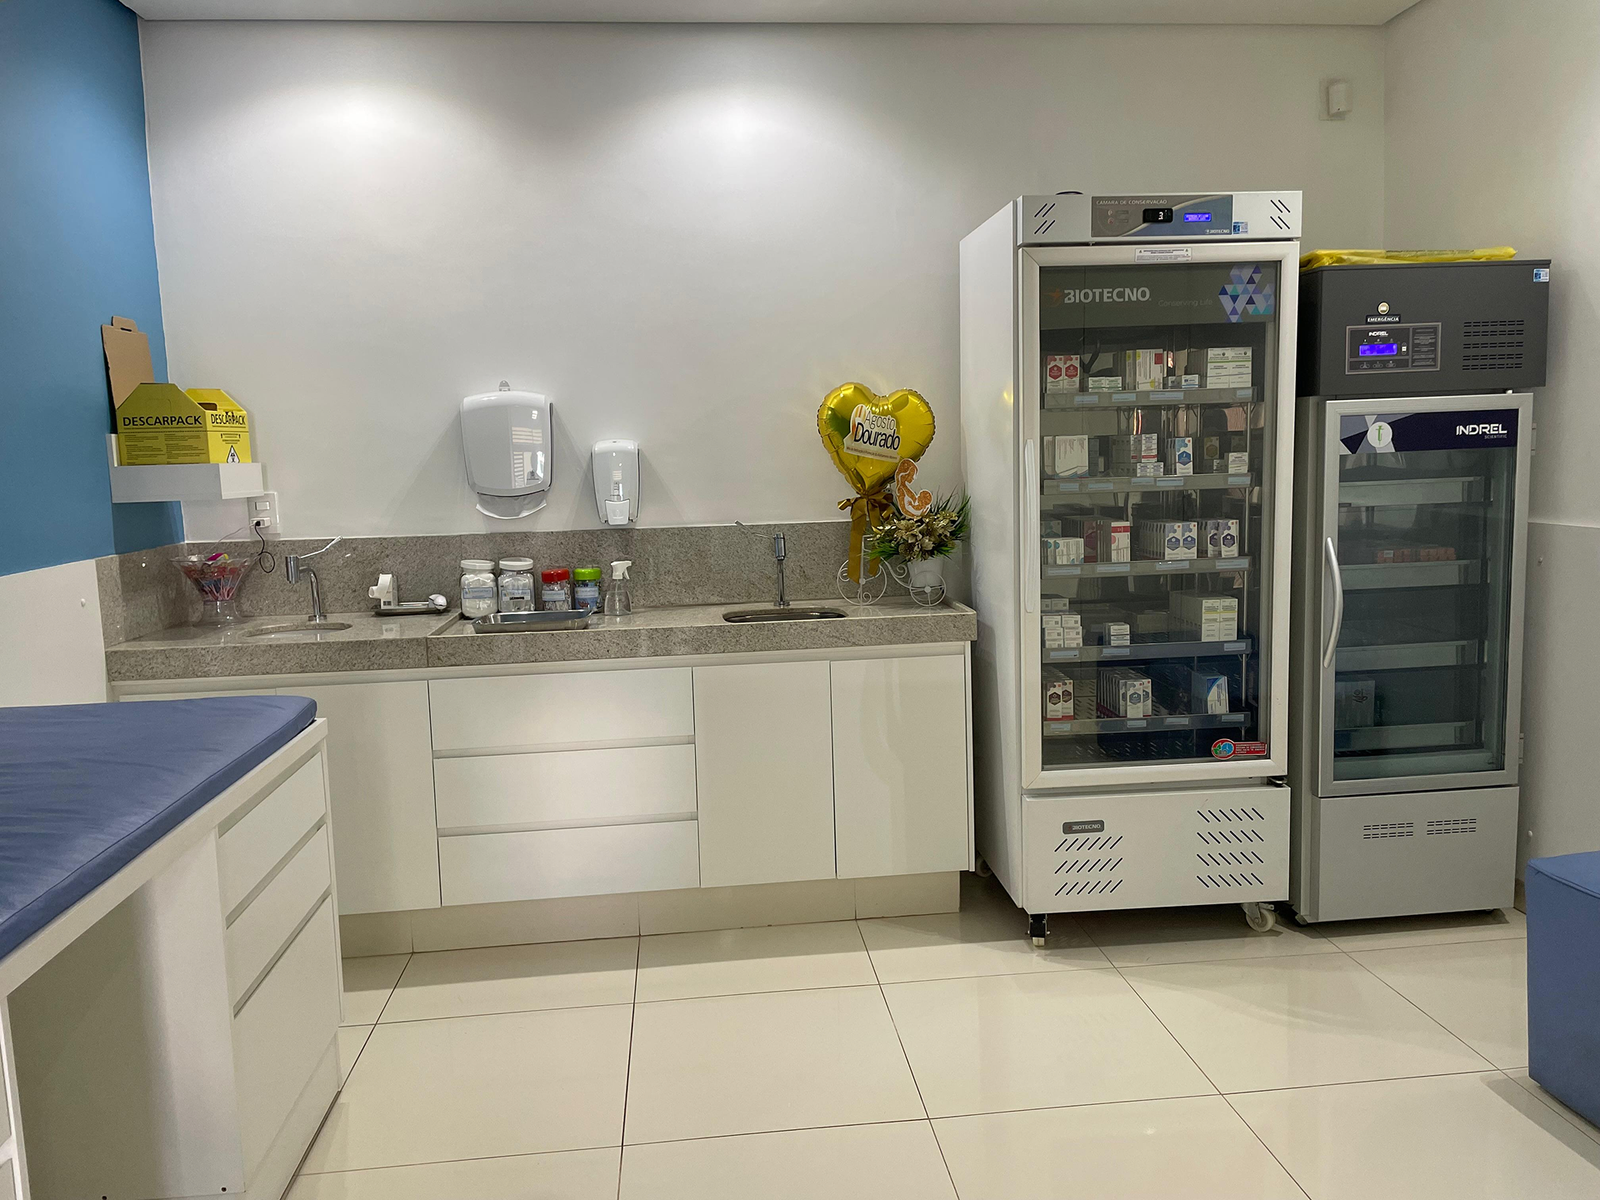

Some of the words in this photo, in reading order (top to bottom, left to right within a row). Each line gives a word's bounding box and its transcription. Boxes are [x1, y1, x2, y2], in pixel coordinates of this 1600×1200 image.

[1158, 211, 1164, 220] 3
[1064, 287, 1151, 303] BIOTECNO
[1158, 299, 1198, 307] Conserving
[122, 415, 203, 426] DESCARPACK
[210, 413, 246, 426] DESCARPACK
[864, 411, 896, 430] Agosto
[1456, 424, 1508, 435] INDREL
[854, 422, 900, 450] Dourado
